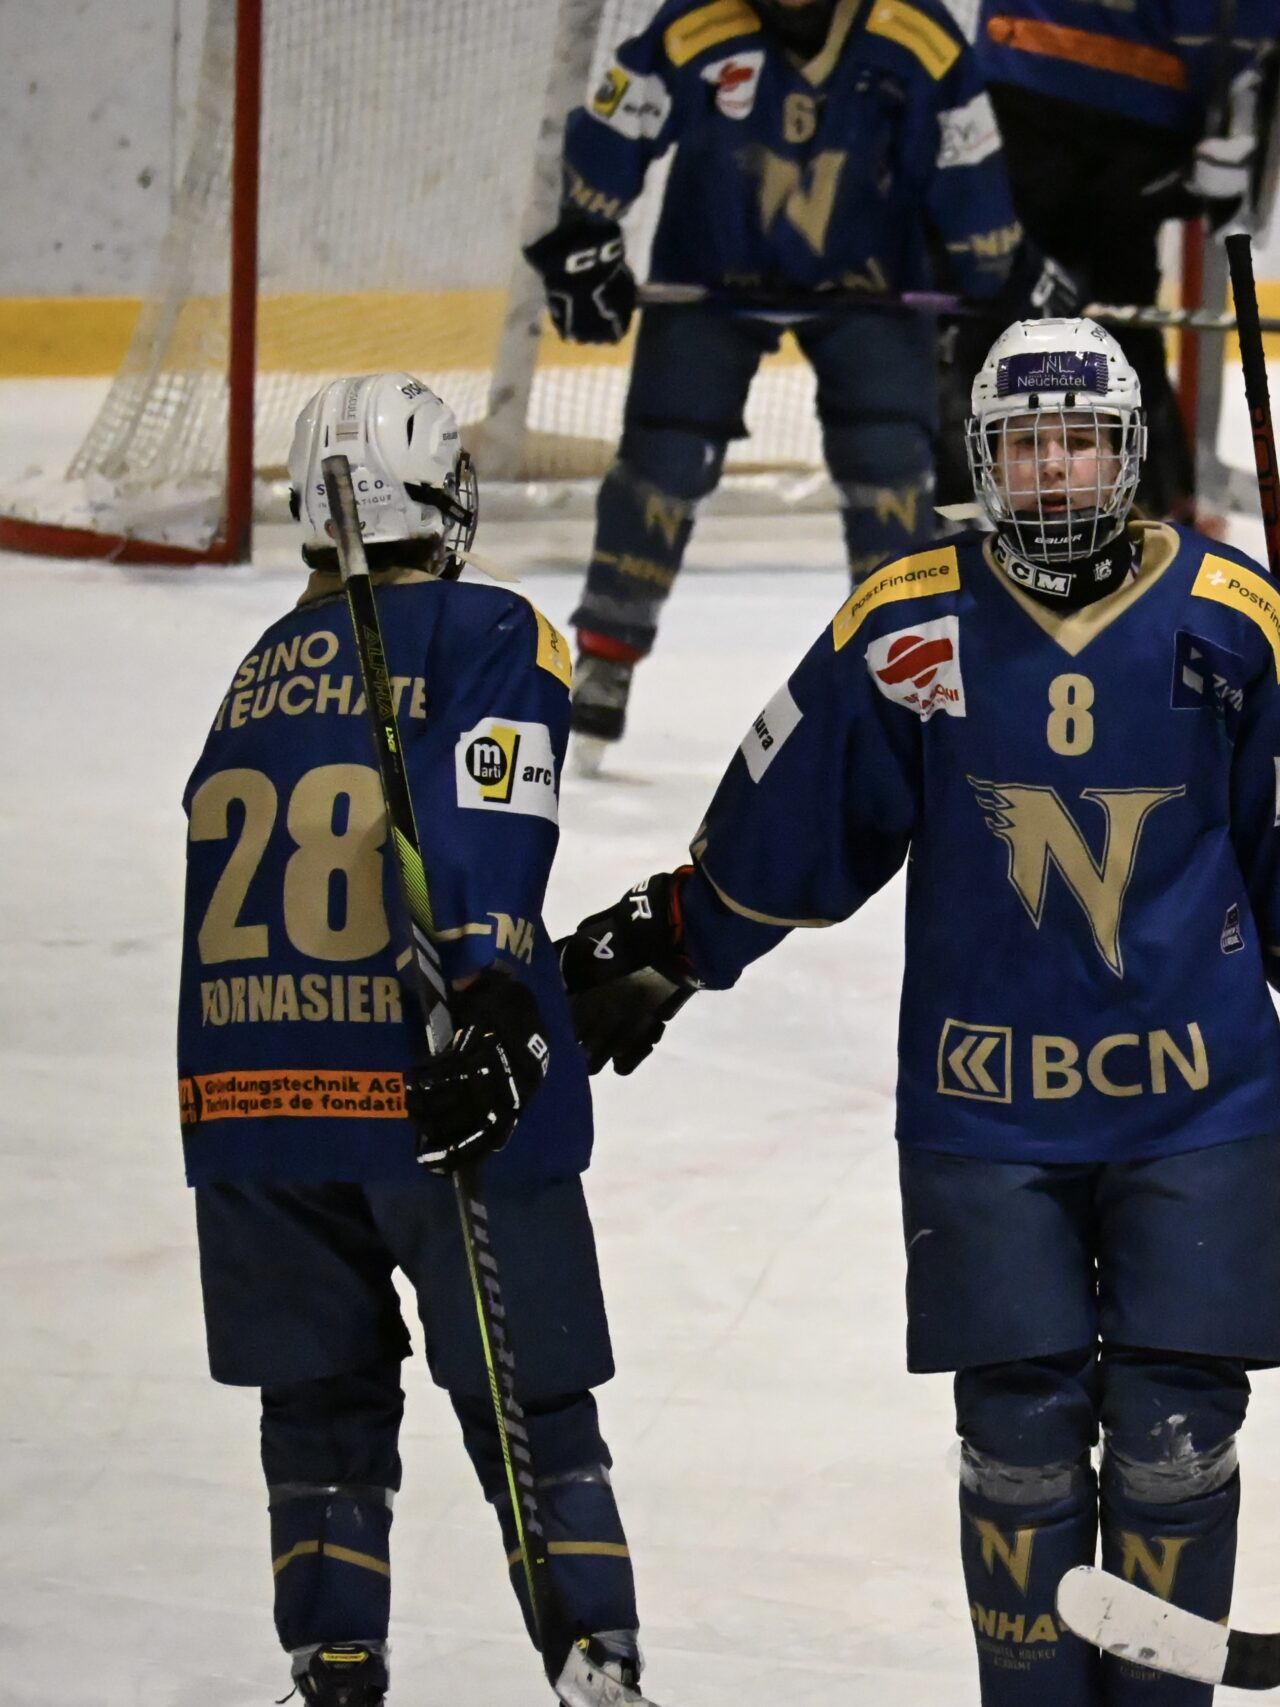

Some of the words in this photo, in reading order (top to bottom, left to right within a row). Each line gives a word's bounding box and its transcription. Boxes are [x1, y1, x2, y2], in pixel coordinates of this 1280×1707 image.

[783, 93, 818, 144] 6
[1017, 375, 1087, 388] Neuchâtel
[851, 564, 950, 617] PostFinance
[1047, 673, 1094, 756] 8
[186, 763, 394, 966] 28
[966, 775, 1187, 980] N
[368, 1078, 402, 1094] AG
[1032, 1021, 1210, 1101] BCN
[288, 1095, 314, 1111] de
[973, 1519, 1037, 1597] N
[973, 1603, 1058, 1644] NHA
